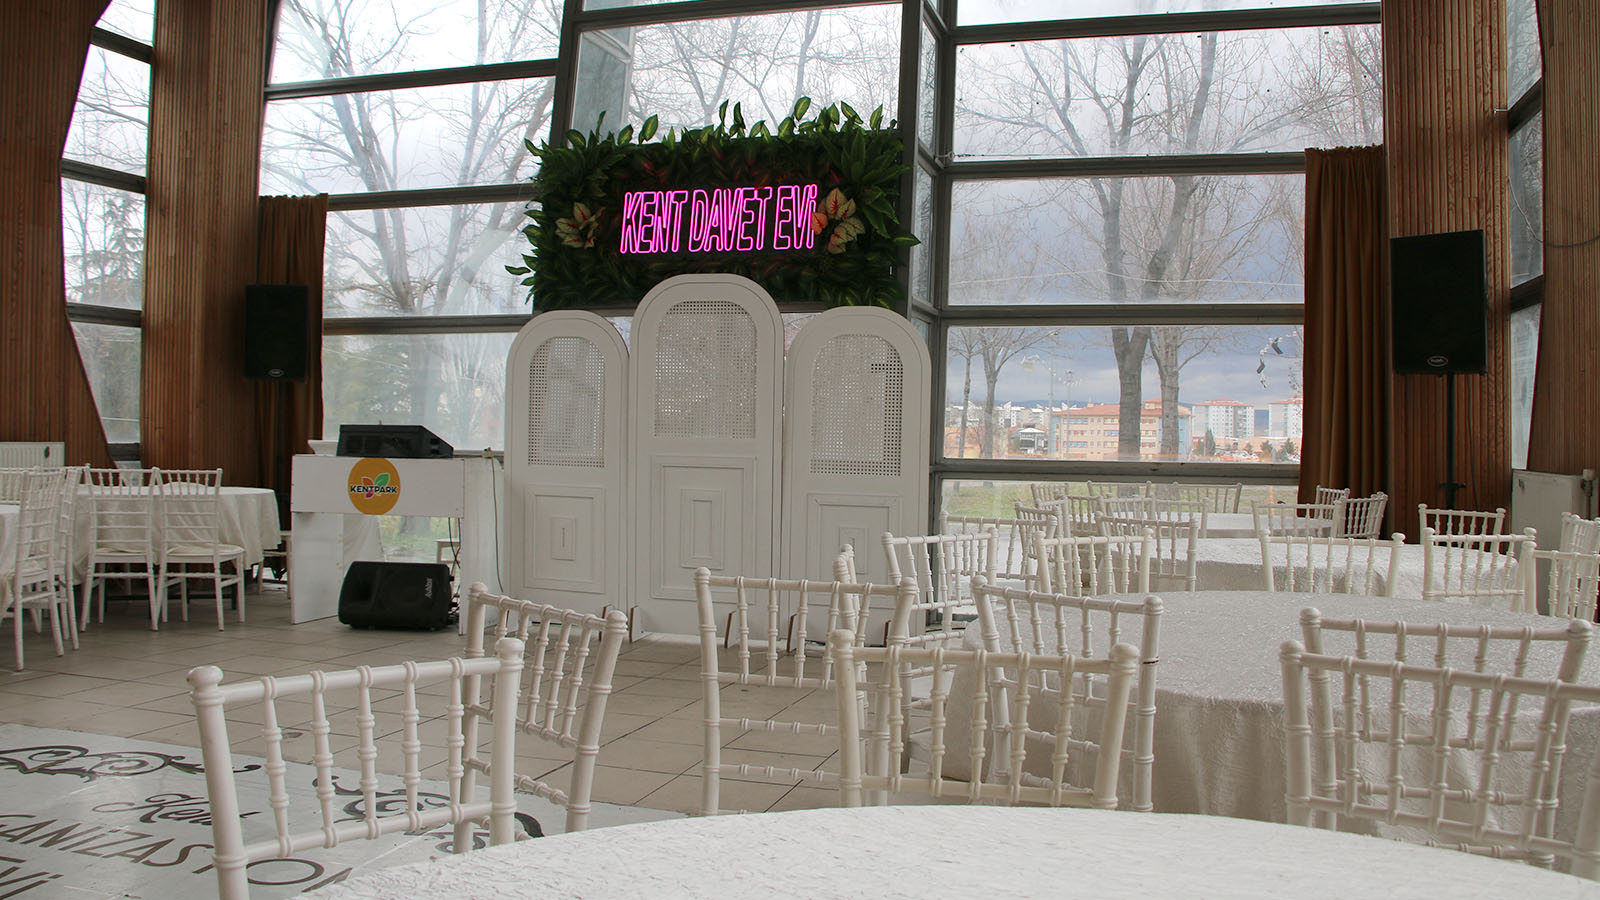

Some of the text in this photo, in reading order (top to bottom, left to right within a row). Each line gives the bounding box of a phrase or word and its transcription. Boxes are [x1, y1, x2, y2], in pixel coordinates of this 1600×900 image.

[620, 190, 689, 254] KENT
[688, 186, 773, 252] DAVET
[350, 485, 398, 494] KENTPARK
